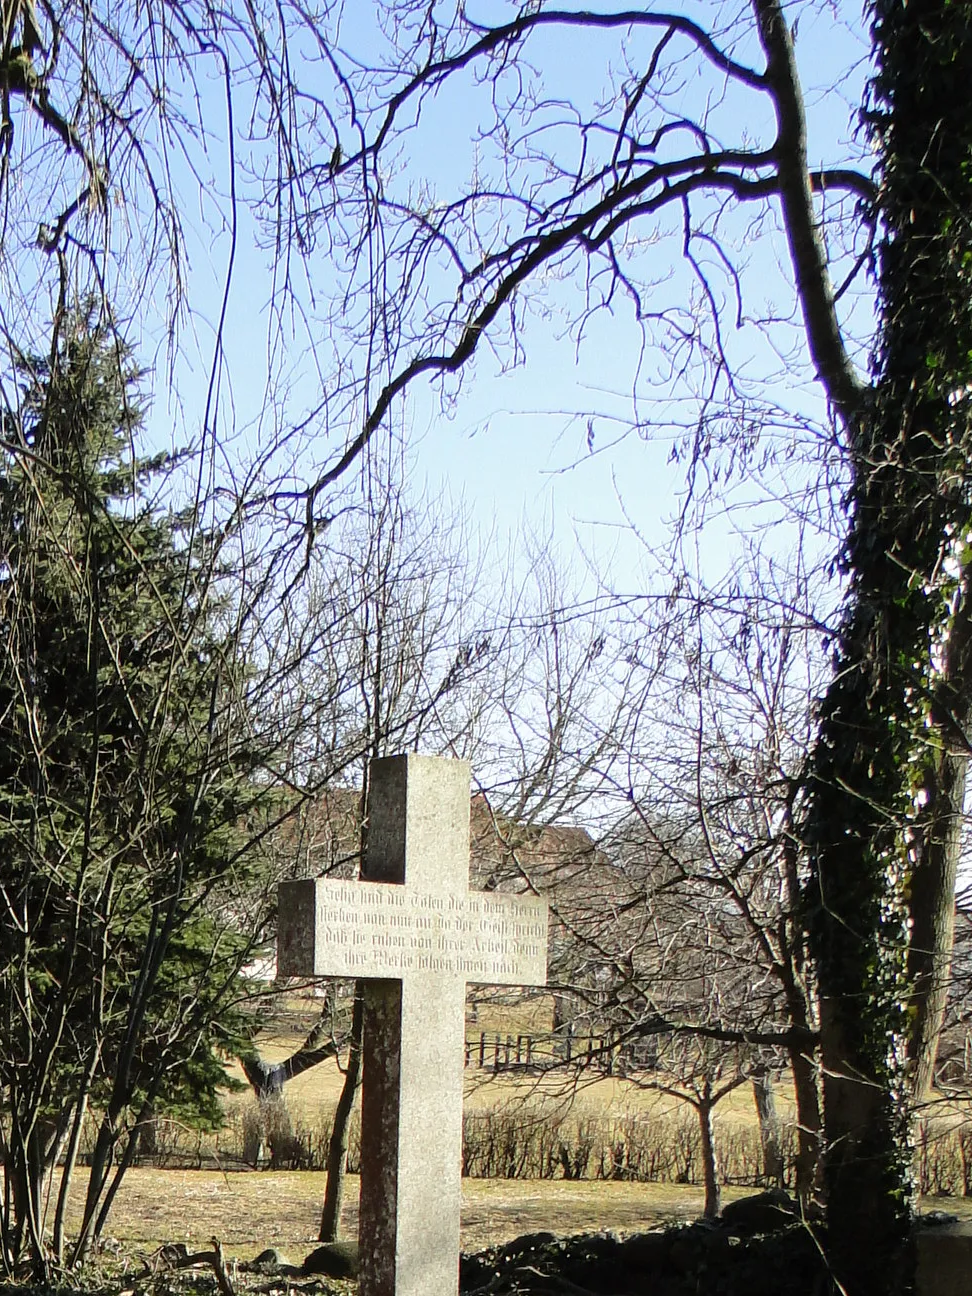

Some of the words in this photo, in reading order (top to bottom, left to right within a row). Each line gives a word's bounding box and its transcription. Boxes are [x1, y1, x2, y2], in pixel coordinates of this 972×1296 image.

[325, 886, 356, 906] Selig
[360, 889, 383, 906] sind
[387, 890, 405, 906] die
[448, 894, 464, 911] die
[469, 898, 479, 913] in
[483, 898, 505, 914] dem
[510, 901, 540, 917] Herrn
[320, 905, 359, 924] sterben
[363, 913, 386, 926] von
[390, 915, 412, 927] nun
[455, 916, 473, 932] der
[477, 919, 508, 936] Geist
[352, 930, 366, 945] sie
[371, 931, 405, 948] ruhen
[410, 937, 432, 950] von
[344, 949, 367, 966] ihre
[372, 950, 413, 968] Werke
[417, 954, 452, 974] folgen
